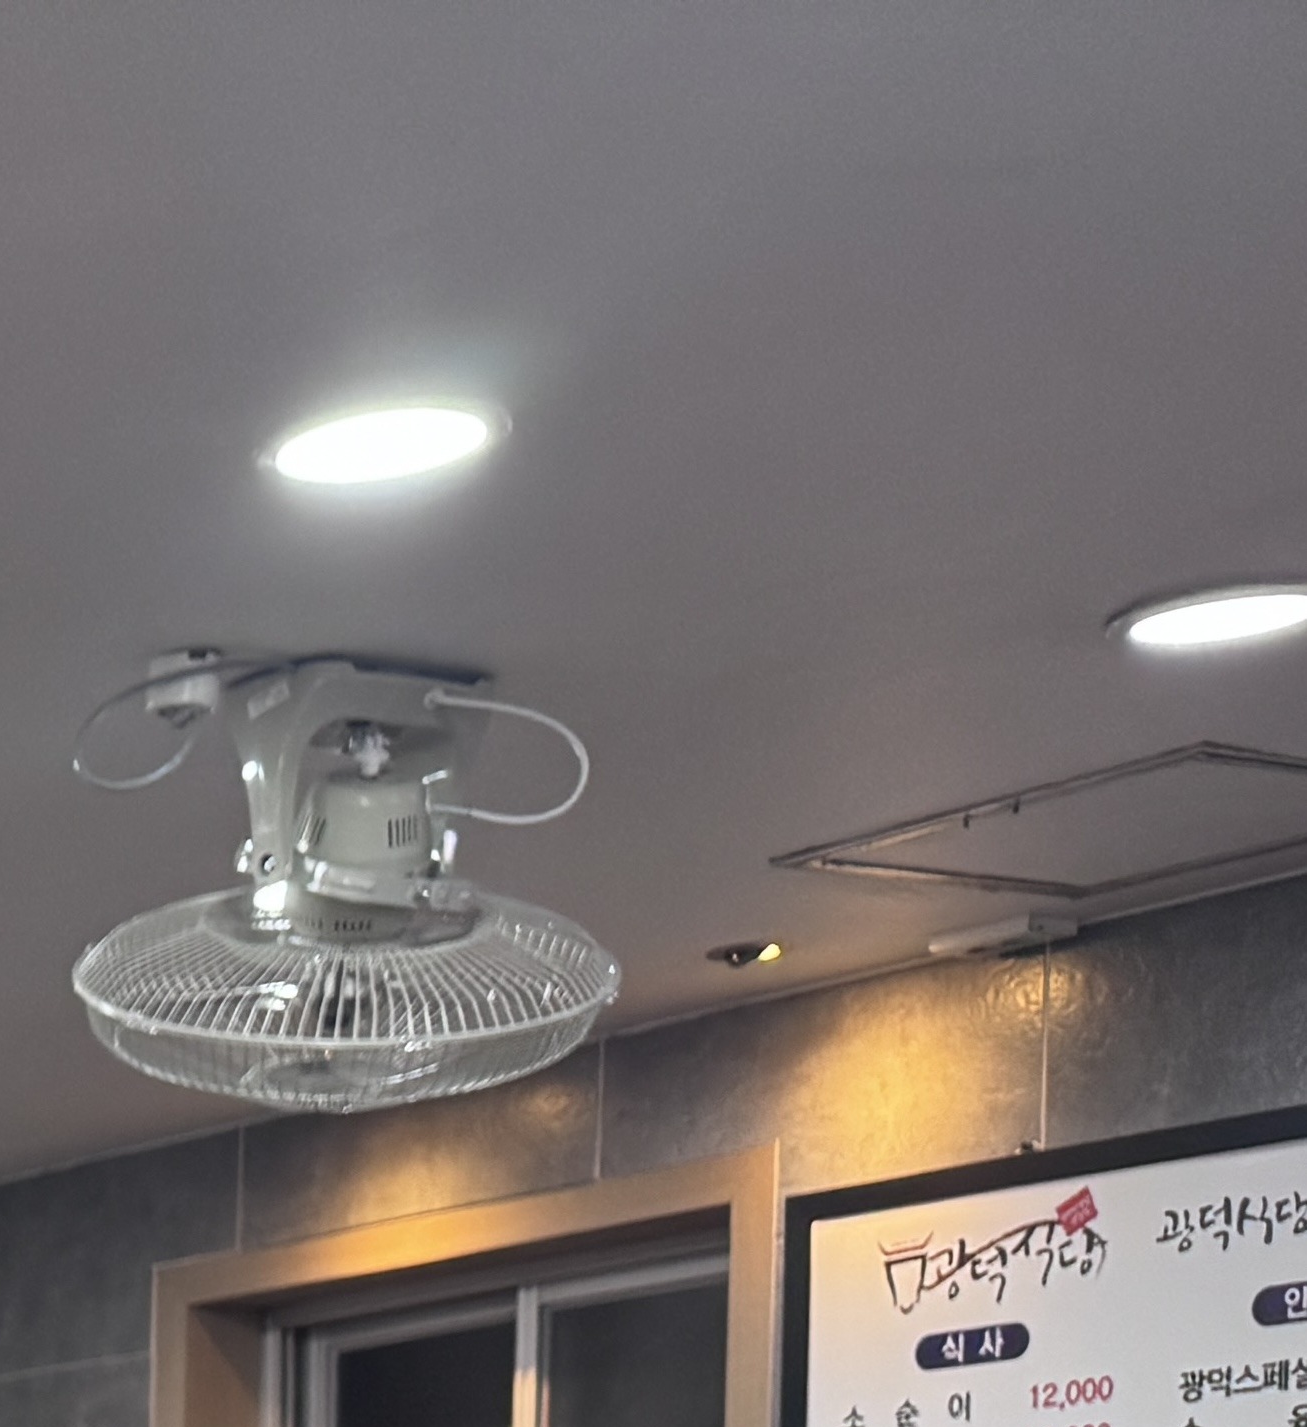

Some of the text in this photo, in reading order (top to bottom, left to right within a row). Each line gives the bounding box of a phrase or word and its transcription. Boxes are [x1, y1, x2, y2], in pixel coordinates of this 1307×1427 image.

[1156, 1190, 1307, 1253] 광덕식당
[928, 1219, 1108, 1304] 광덕식당
[1030, 1374, 1114, 1412] 12,000
